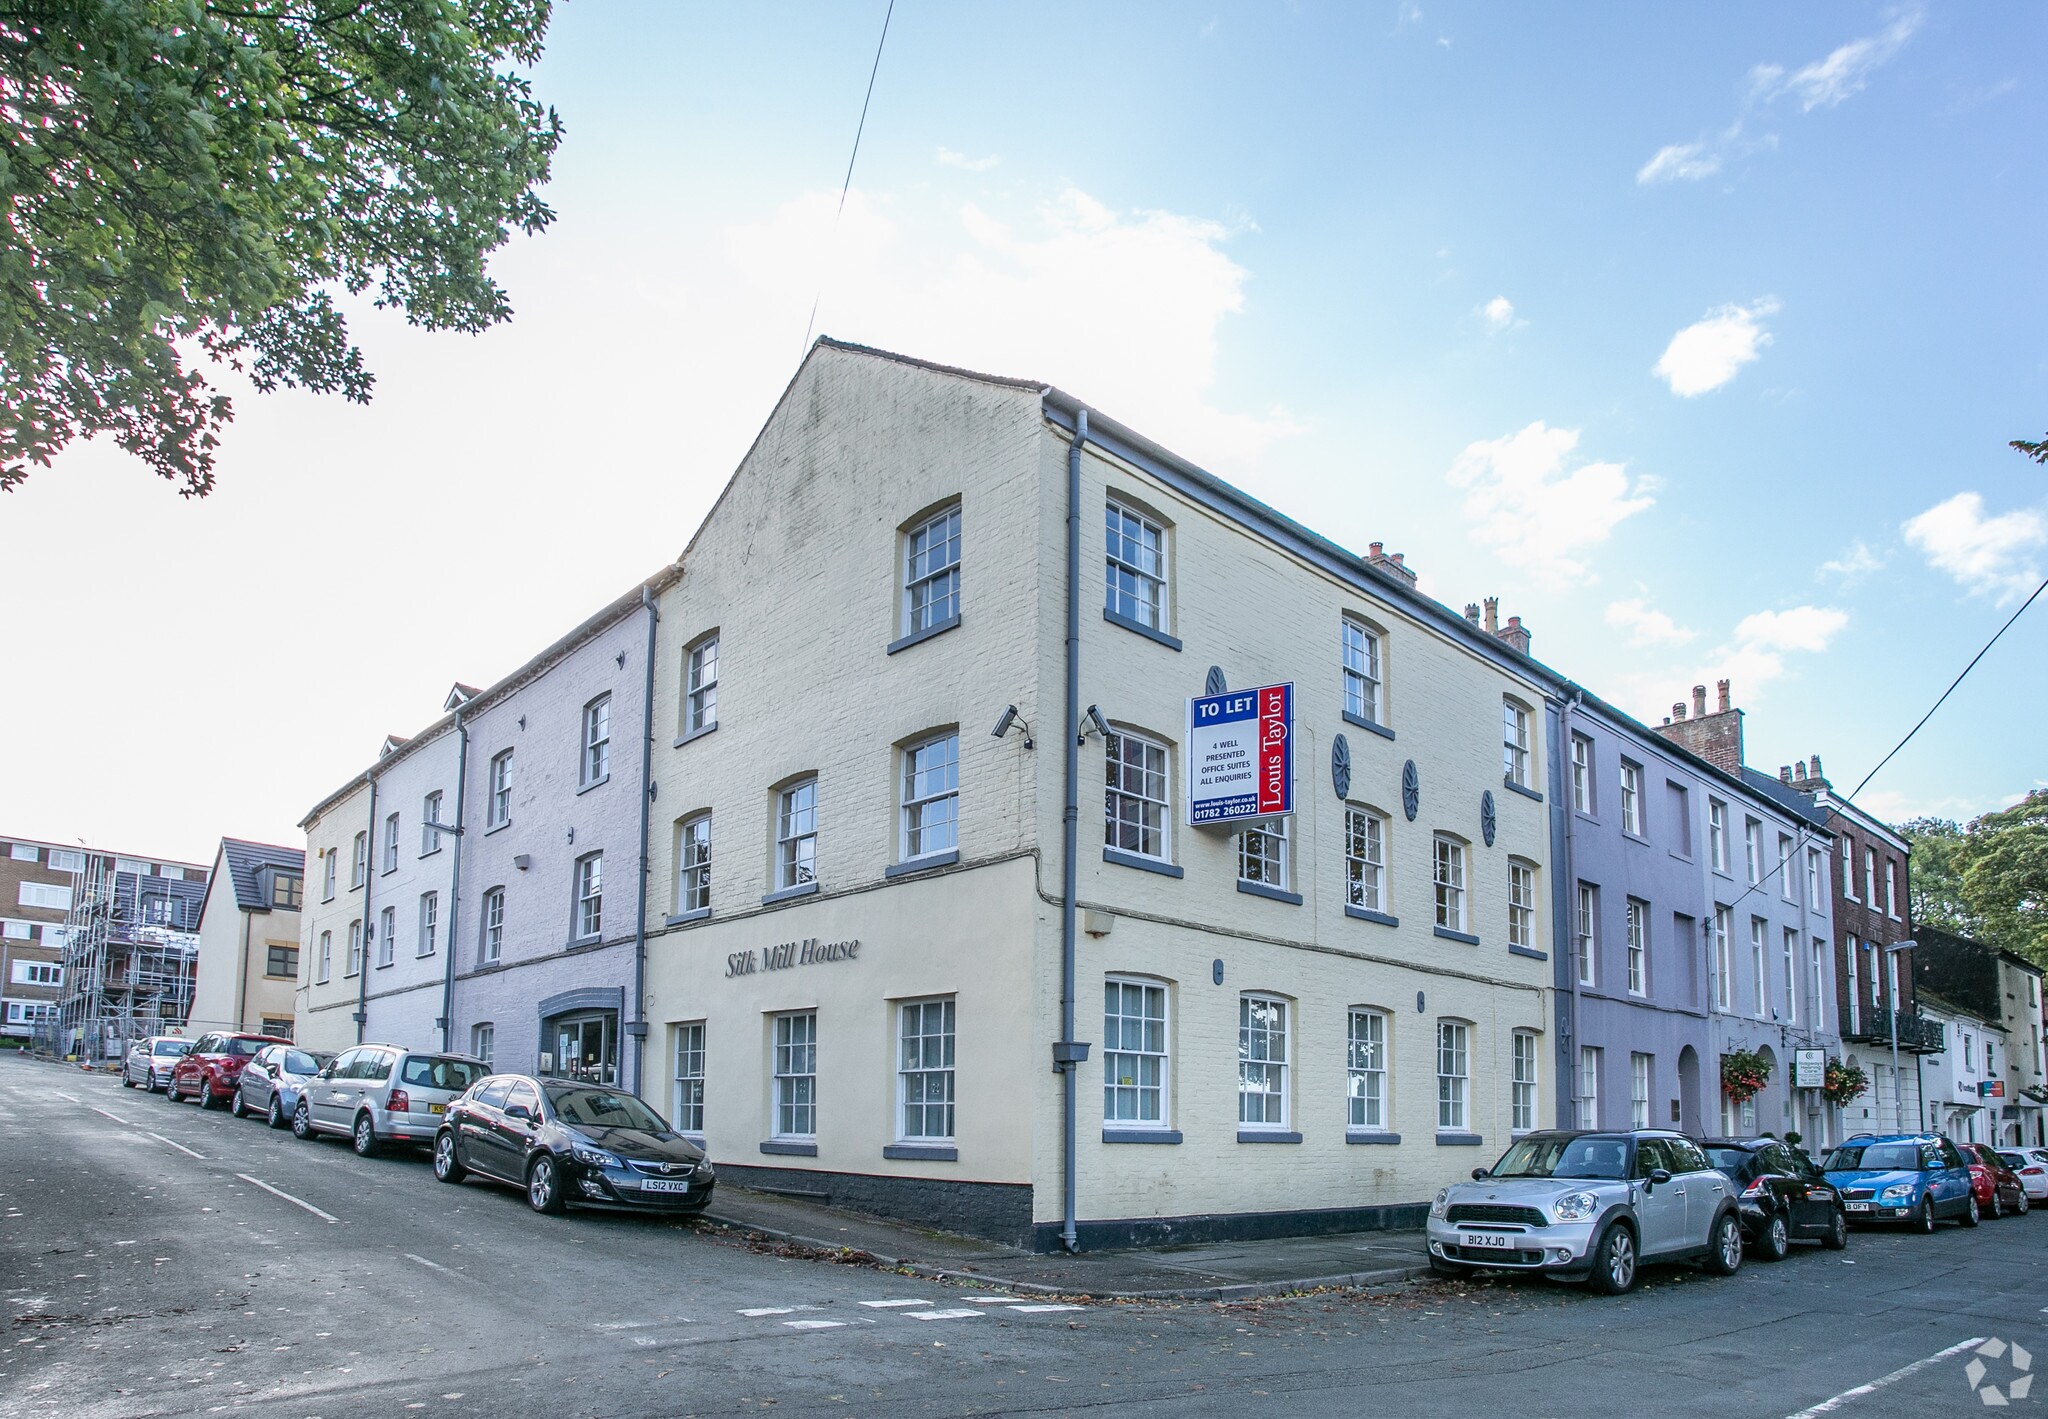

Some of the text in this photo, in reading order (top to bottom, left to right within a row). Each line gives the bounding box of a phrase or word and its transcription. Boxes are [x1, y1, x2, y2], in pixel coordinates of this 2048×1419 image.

[1200, 697, 1252, 717] TO LET
[1212, 740, 1239, 750] 4 WELL
[1262, 693, 1288, 807] Louis Taylor
[1206, 750, 1246, 762] PRESENTED
[1201, 760, 1251, 774] OFFICE SUITES
[1200, 772, 1252, 786] ALL ENQUIRIES
[1195, 795, 1256, 809] www.louis-taylor.co.uk
[1194, 804, 1256, 819] 01782 260222
[725, 938, 860, 978] Silk Mill House
[646, 1180, 684, 1191] LS12 VXC
[1468, 1235, 1505, 1246] B12 XJO
